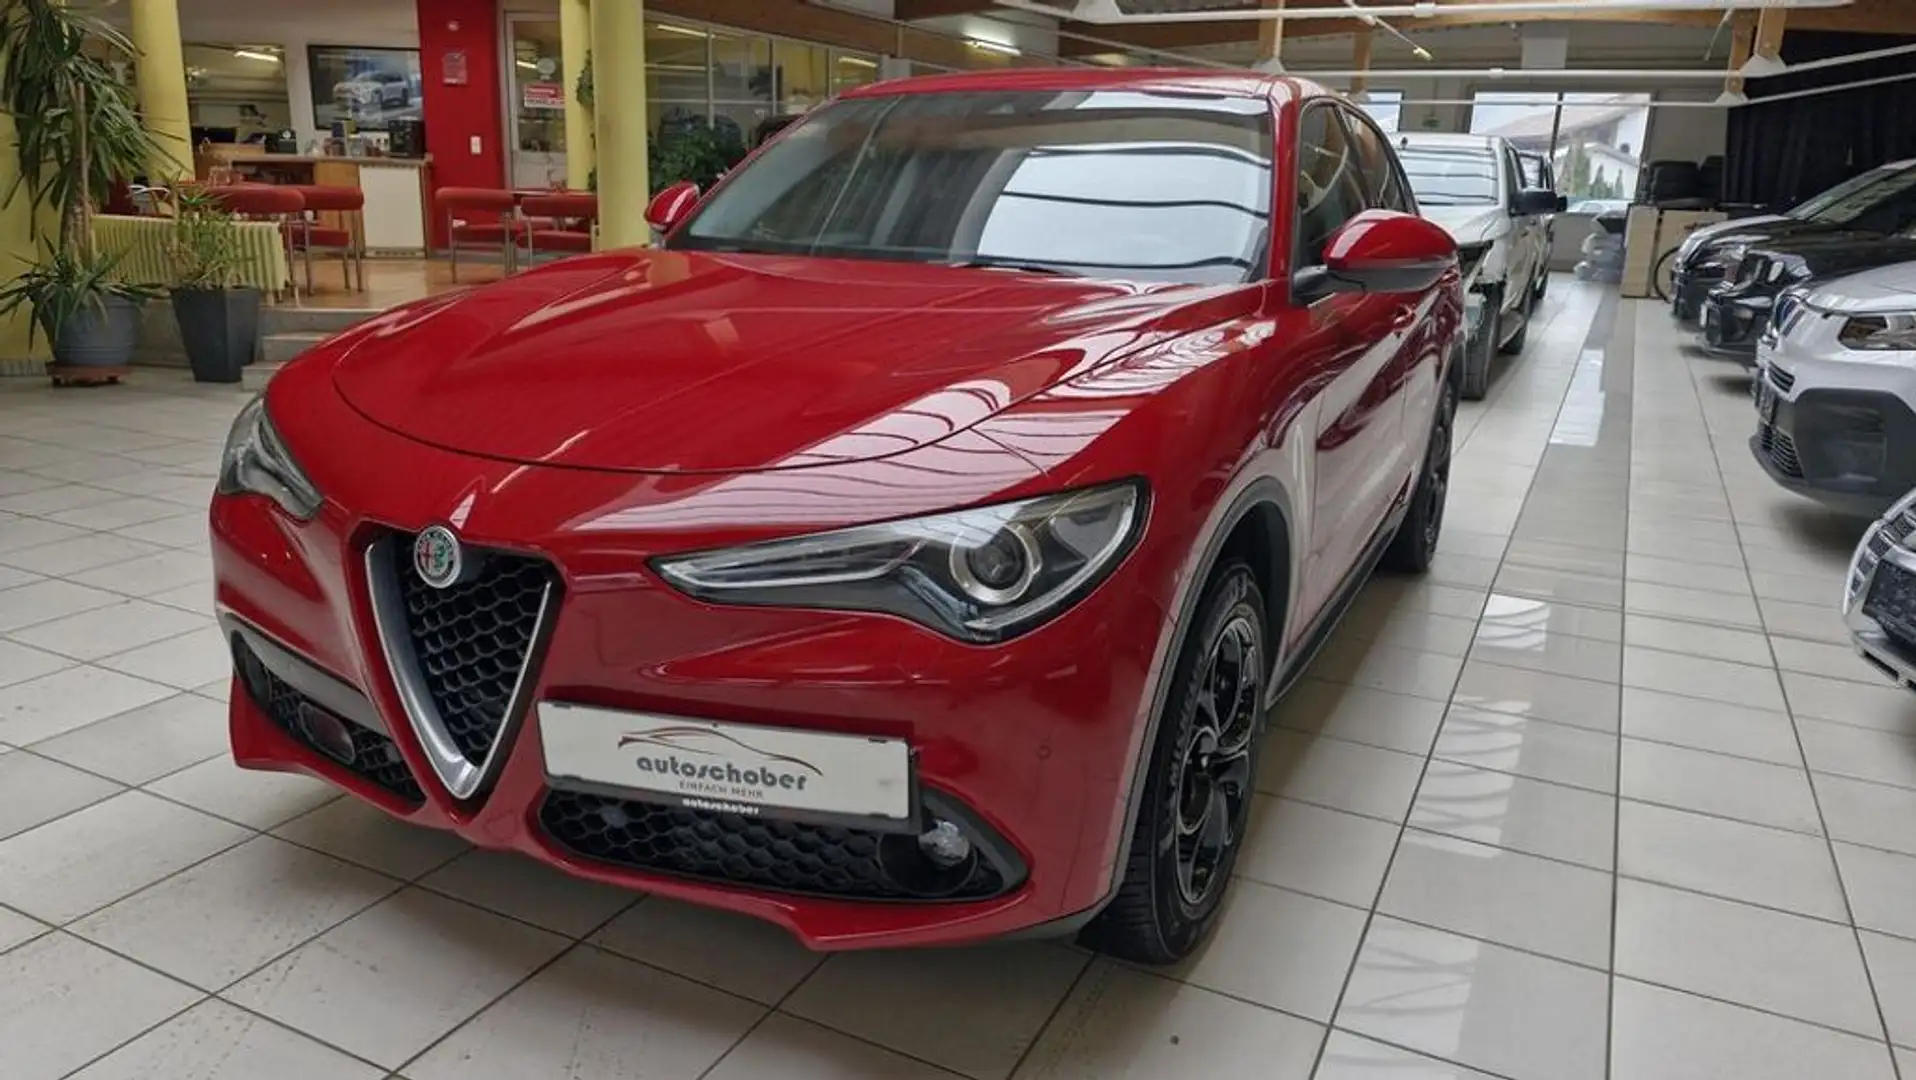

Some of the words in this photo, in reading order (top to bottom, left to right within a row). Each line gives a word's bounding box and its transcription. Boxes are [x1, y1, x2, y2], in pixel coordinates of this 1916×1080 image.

[636, 755, 808, 791] autoschober
[679, 780, 728, 795] EINFACH
[731, 787, 764, 799] MEHR
